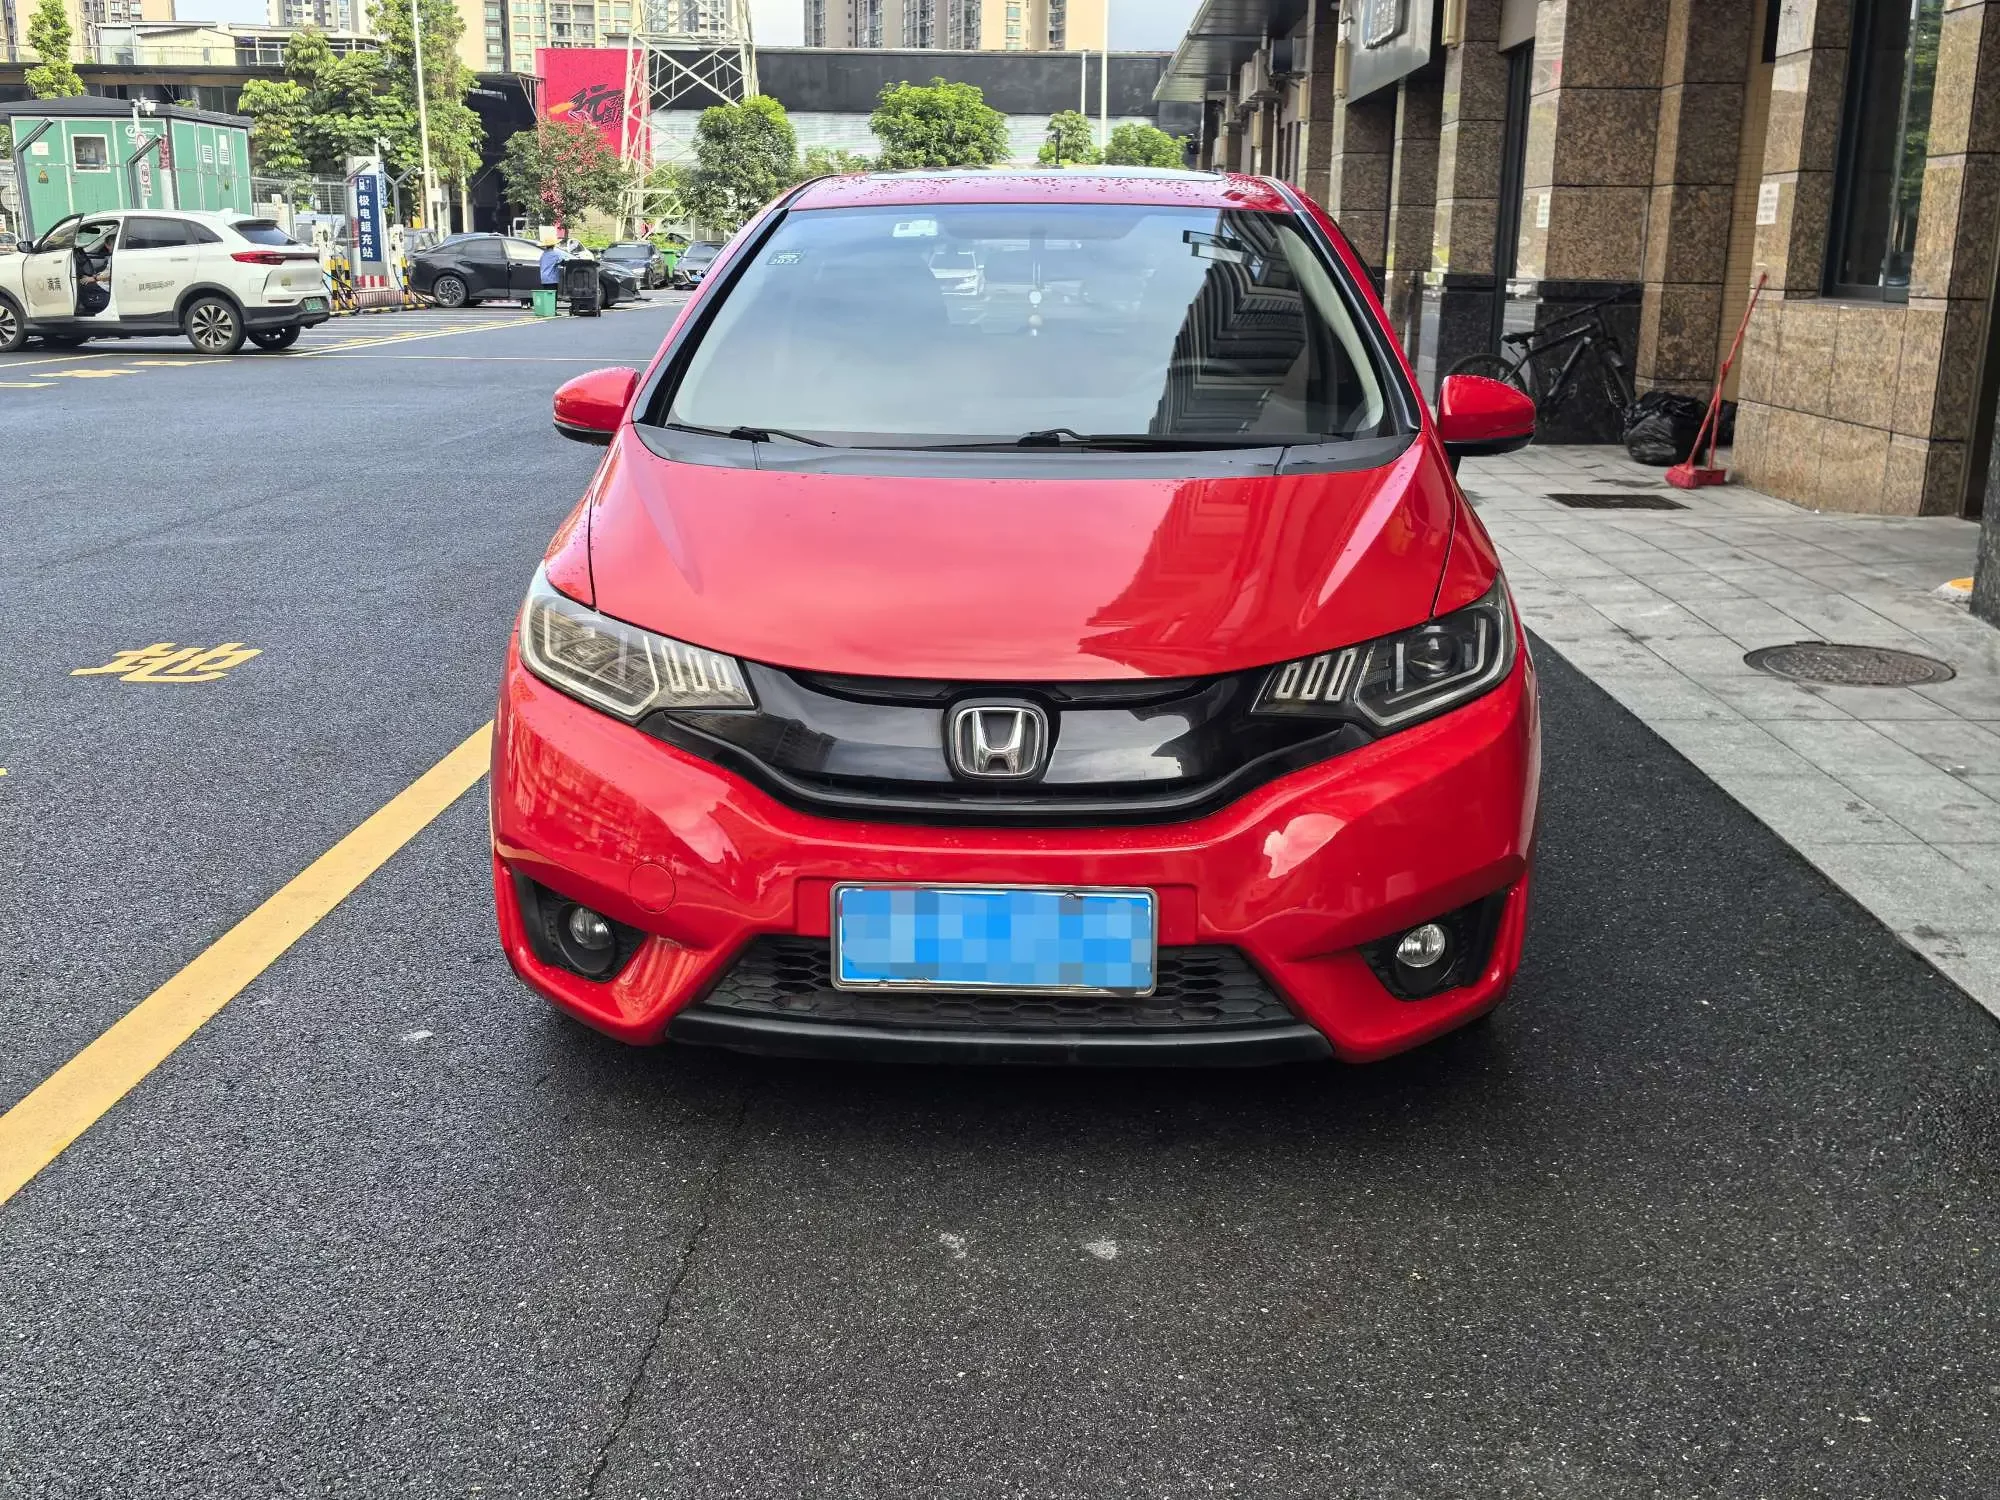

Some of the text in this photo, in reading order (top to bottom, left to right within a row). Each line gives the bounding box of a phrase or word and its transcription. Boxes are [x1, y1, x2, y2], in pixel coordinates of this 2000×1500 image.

[358, 195, 374, 258] 极电超充站
[70, 642, 264, 683] 地
